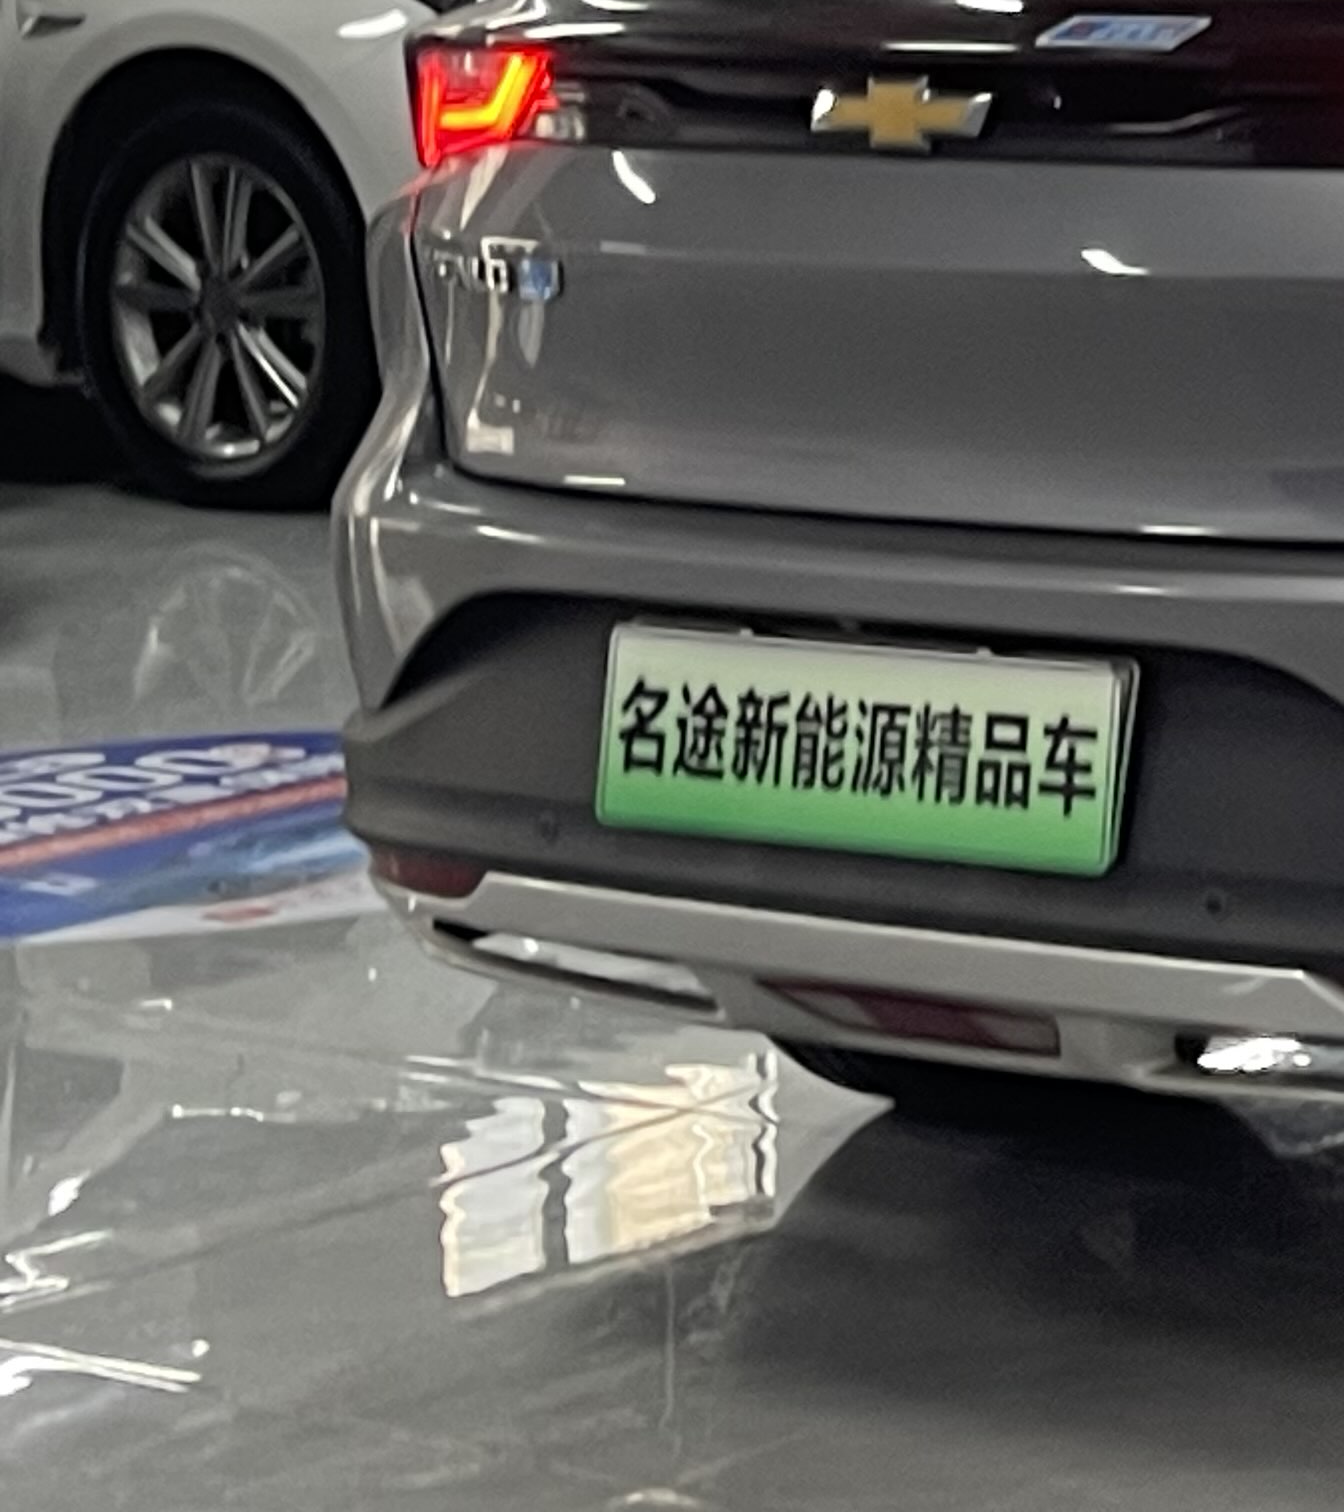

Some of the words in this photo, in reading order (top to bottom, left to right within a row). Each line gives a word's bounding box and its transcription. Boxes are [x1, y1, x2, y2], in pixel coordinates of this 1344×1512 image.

[617, 676, 1099, 817] 名途新能源精品车
